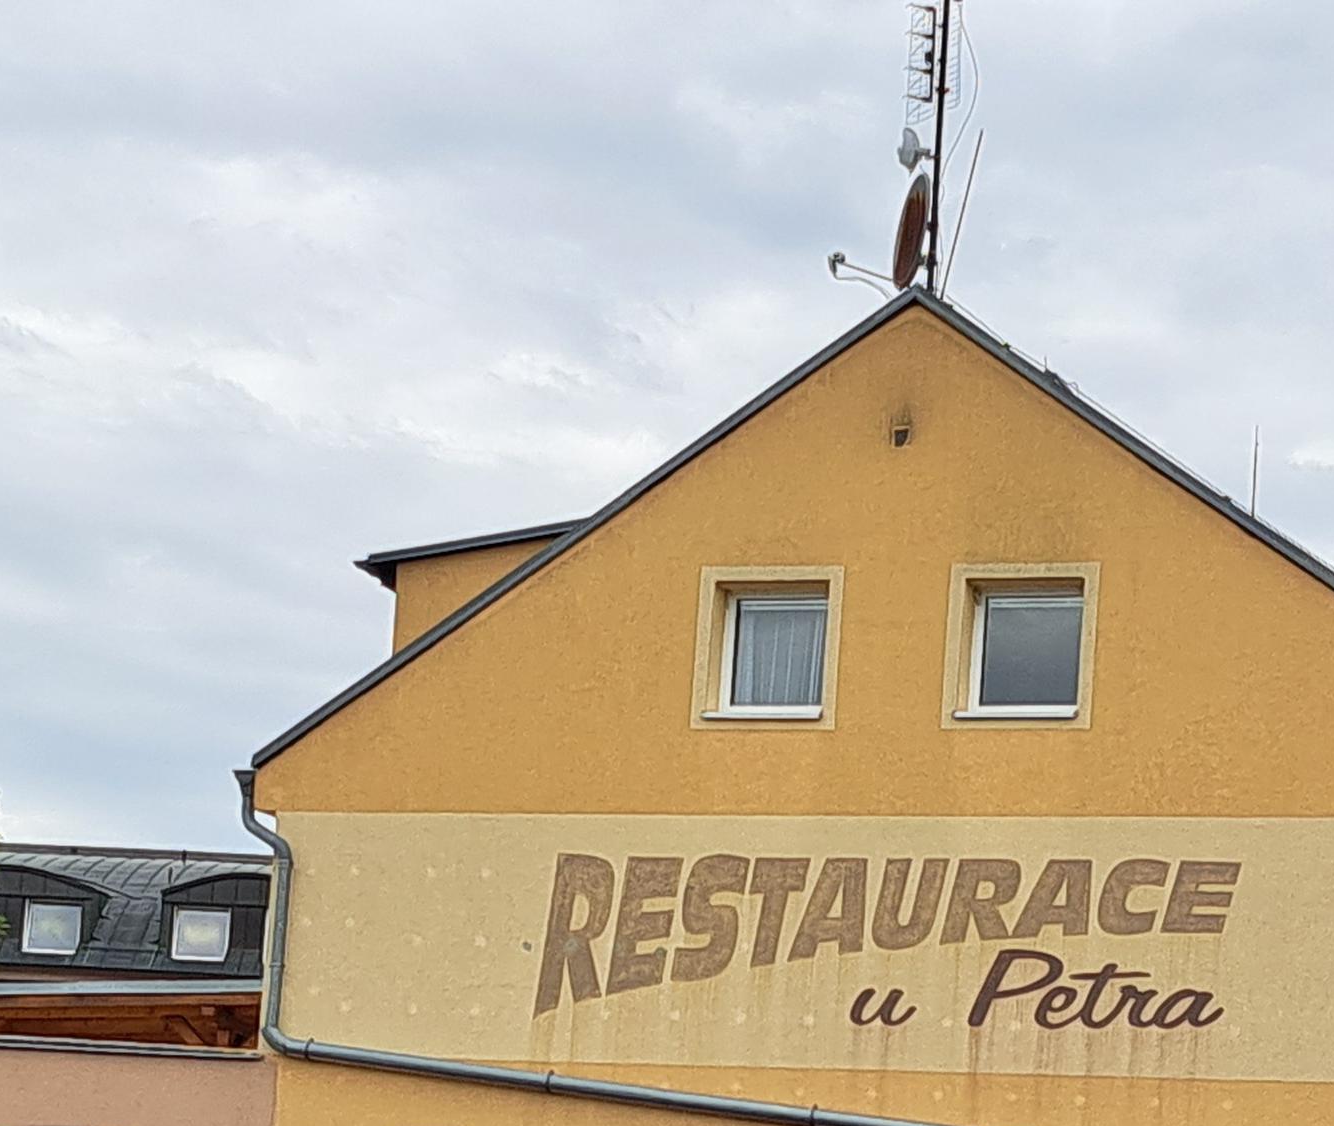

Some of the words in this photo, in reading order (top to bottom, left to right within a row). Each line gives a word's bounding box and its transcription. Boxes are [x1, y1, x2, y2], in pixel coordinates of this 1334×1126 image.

[533, 852, 1243, 1020] RESTAURACE
[850, 983, 917, 1028] u
[965, 948, 1225, 1030] Petra
